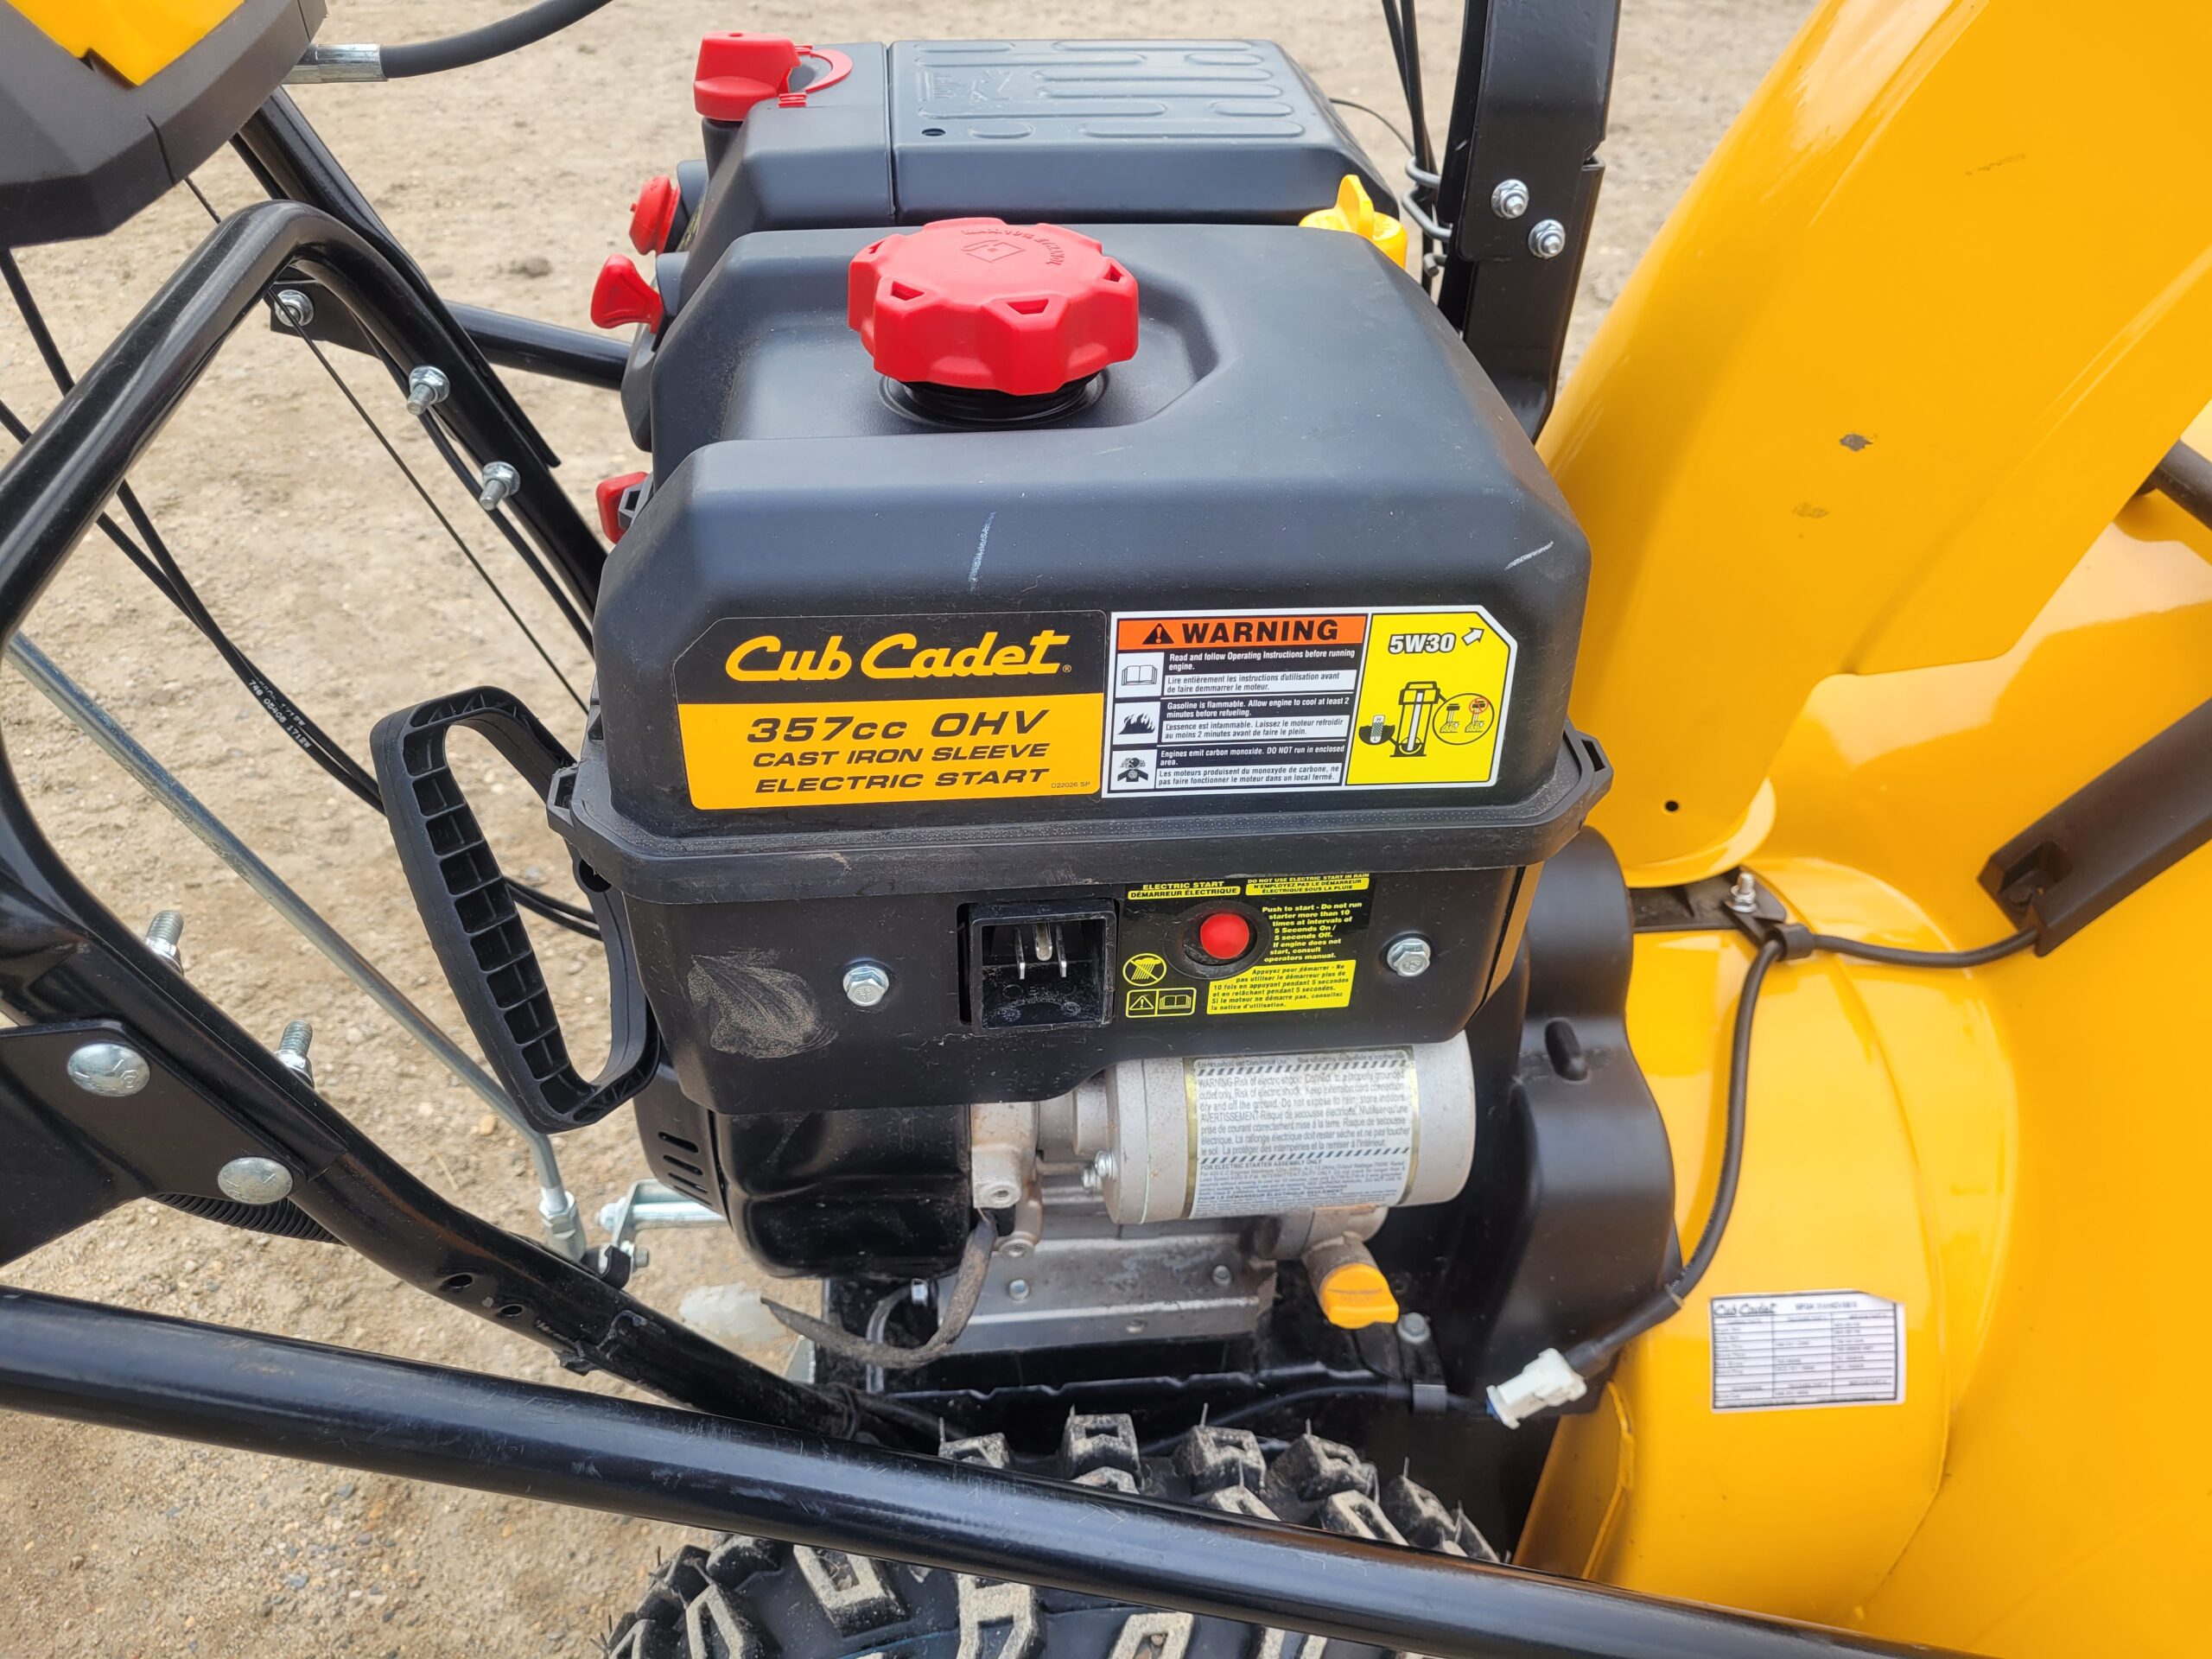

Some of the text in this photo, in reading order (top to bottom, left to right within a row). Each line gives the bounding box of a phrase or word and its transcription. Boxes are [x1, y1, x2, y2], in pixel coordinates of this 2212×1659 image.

[1181, 620, 1338, 644] WARNING
[1389, 632, 1456, 654] 5W30
[726, 634, 851, 682] Cub
[1170, 653, 1187, 662] Read
[1228, 652, 1262, 661] Operating
[1263, 651, 1303, 659] Instructions
[1329, 649, 1355, 658] running
[1169, 663, 1195, 671] engine.
[1269, 699, 1292, 708] engine
[1219, 709, 1252, 717] refueling.
[747, 709, 1050, 743] 357cc OHV
[1288, 728, 1307, 736] plein.
[753, 743, 1050, 768] CAST IRON SLEEVE
[1161, 750, 1187, 759] Engines
[1315, 745, 1345, 753] enclosed
[1203, 768, 1240, 777] produisent
[755, 769, 1050, 793] ELECTRIC START
[1185, 887, 1237, 896] ÉLECTRIQUE
